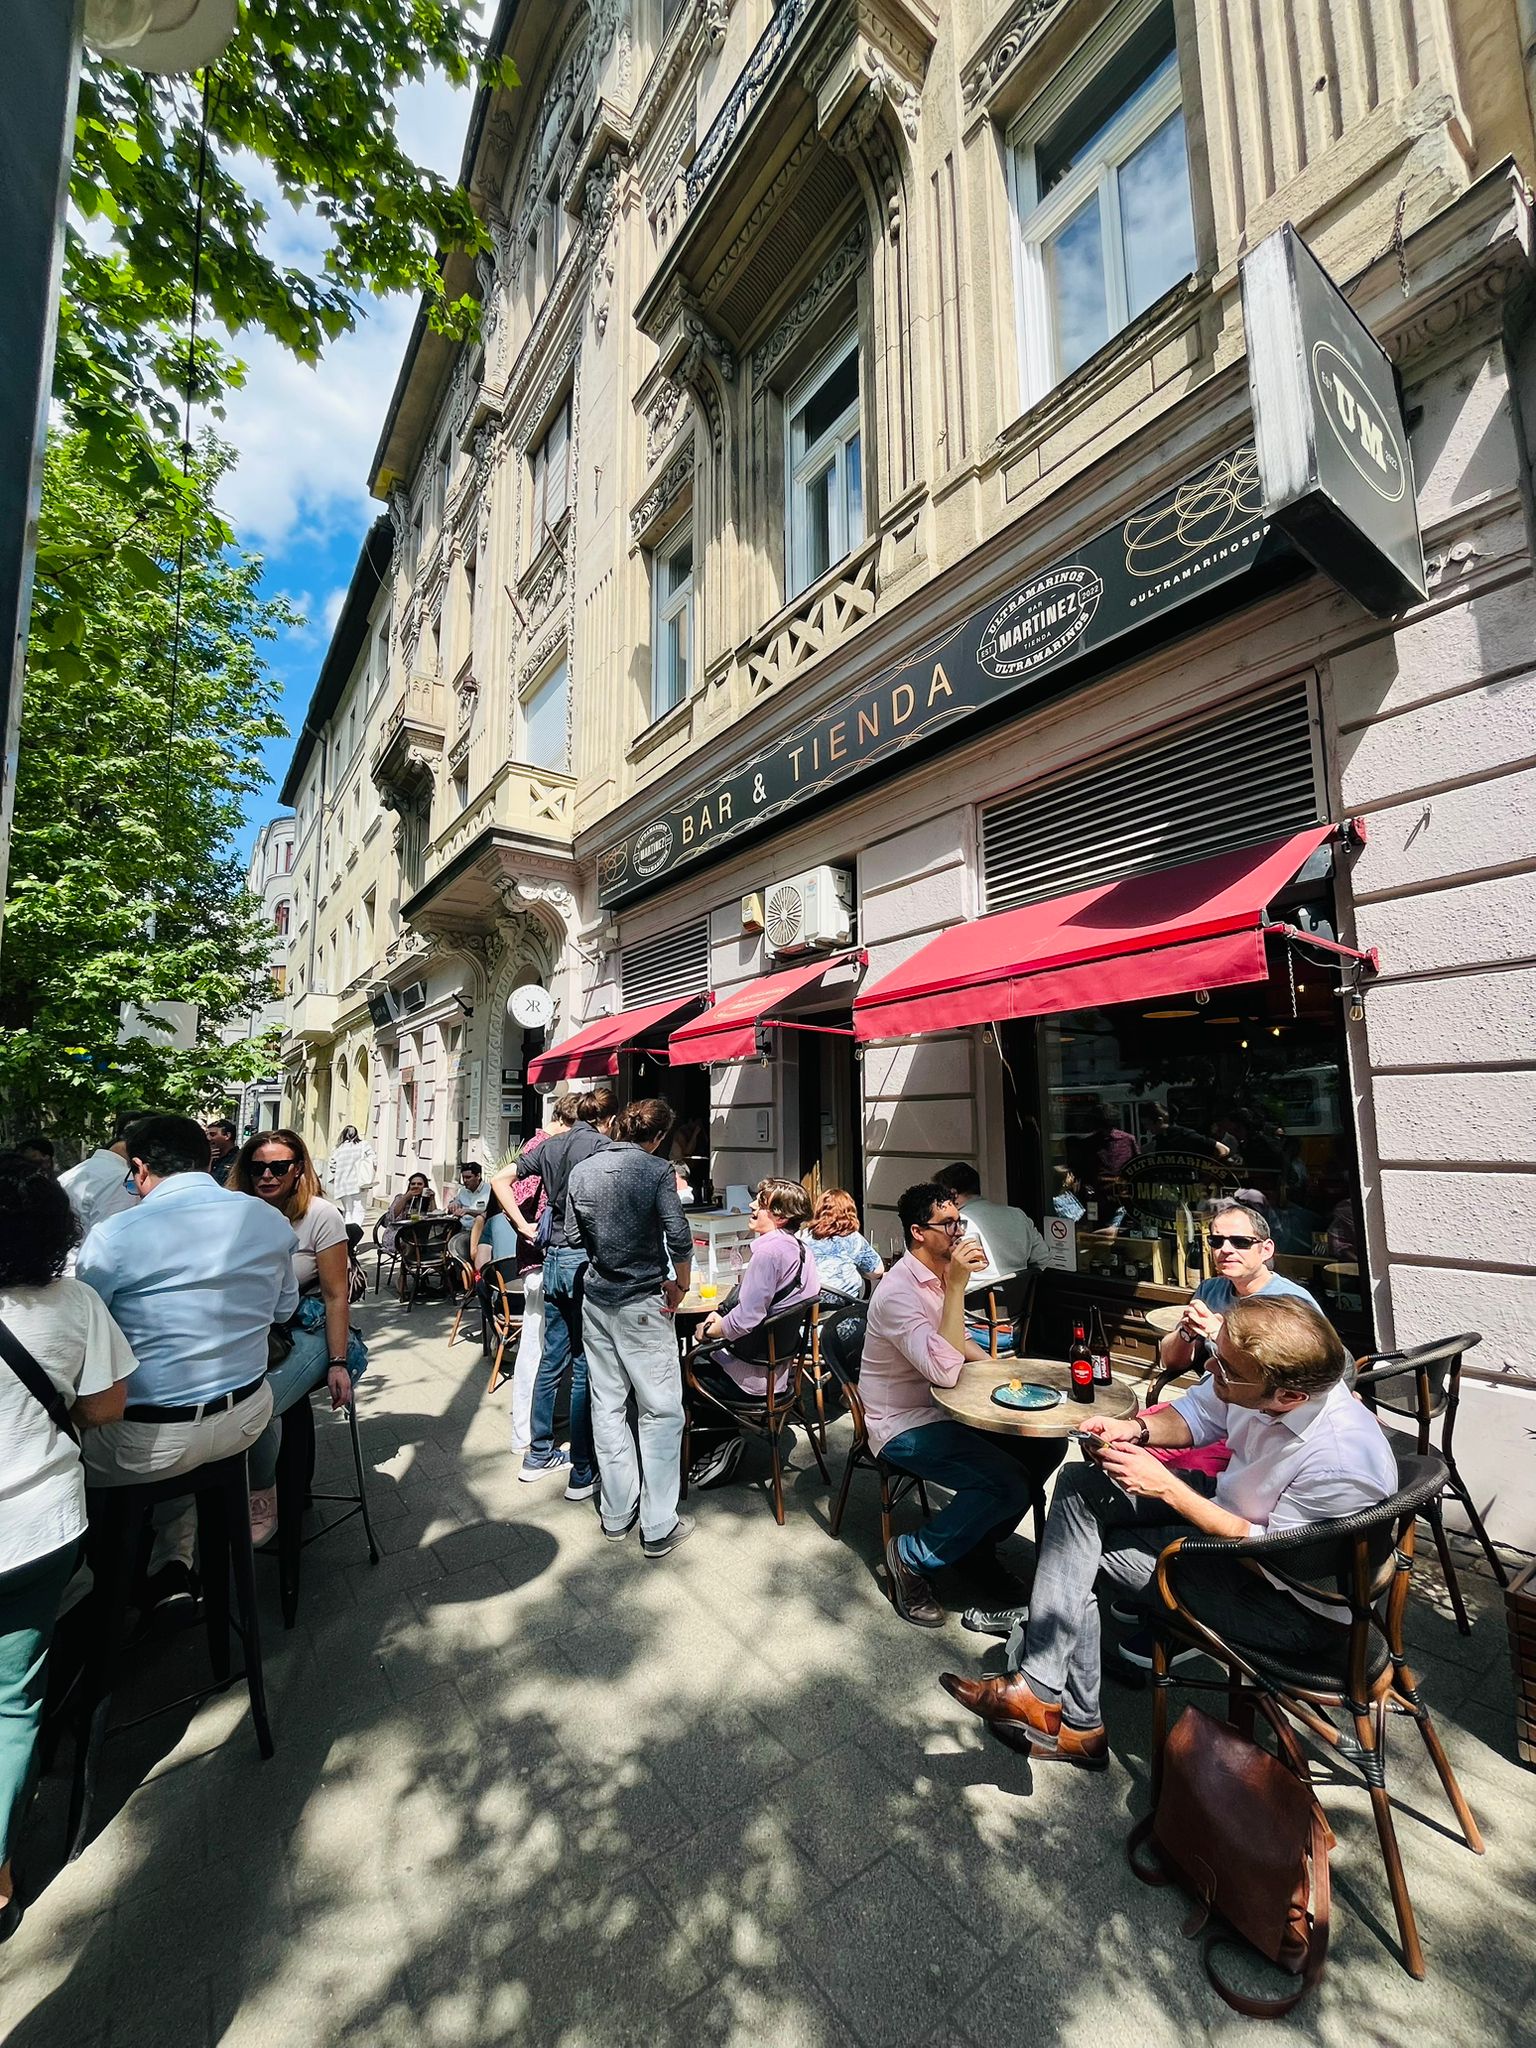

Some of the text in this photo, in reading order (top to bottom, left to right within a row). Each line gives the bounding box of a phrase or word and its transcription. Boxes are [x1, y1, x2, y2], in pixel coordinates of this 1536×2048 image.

[1332, 372, 1387, 474] UM
[1081, 584, 1100, 600] 2022
[1129, 524, 1271, 607] @ULTRAMARINOSBP
[988, 571, 1086, 634] ULTRAMARINOS
[999, 592, 1077, 653] MARTINEZ
[1027, 601, 1043, 614] BAR
[980, 646, 993, 658] EST
[994, 611, 1090, 674] ULTRAMARINOS
[1023, 631, 1052, 650] TIENDA
[682, 792, 732, 845] BAR
[752, 772, 767, 803] &
[788, 662, 953, 782] TIENDA
[1136, 1182, 1217, 1200] MARINEZ
